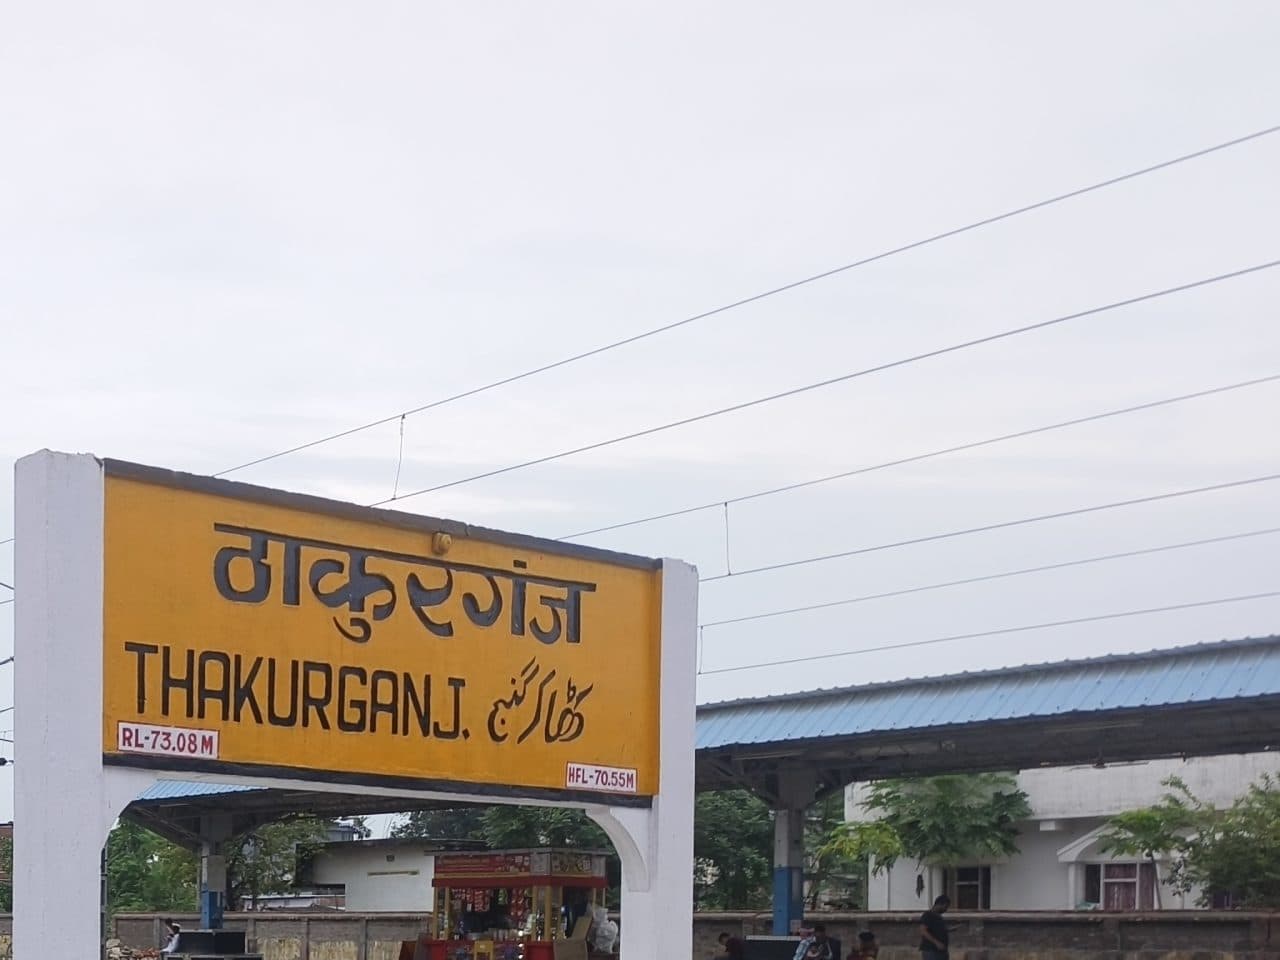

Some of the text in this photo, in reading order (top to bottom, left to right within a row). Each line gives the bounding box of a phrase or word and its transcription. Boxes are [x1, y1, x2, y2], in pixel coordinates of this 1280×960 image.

[213, 522, 597, 643] ठाकुरगंज
[124, 641, 470, 741] THAKURGANJ.
[568, 766, 635, 789] HFL-70.55M
